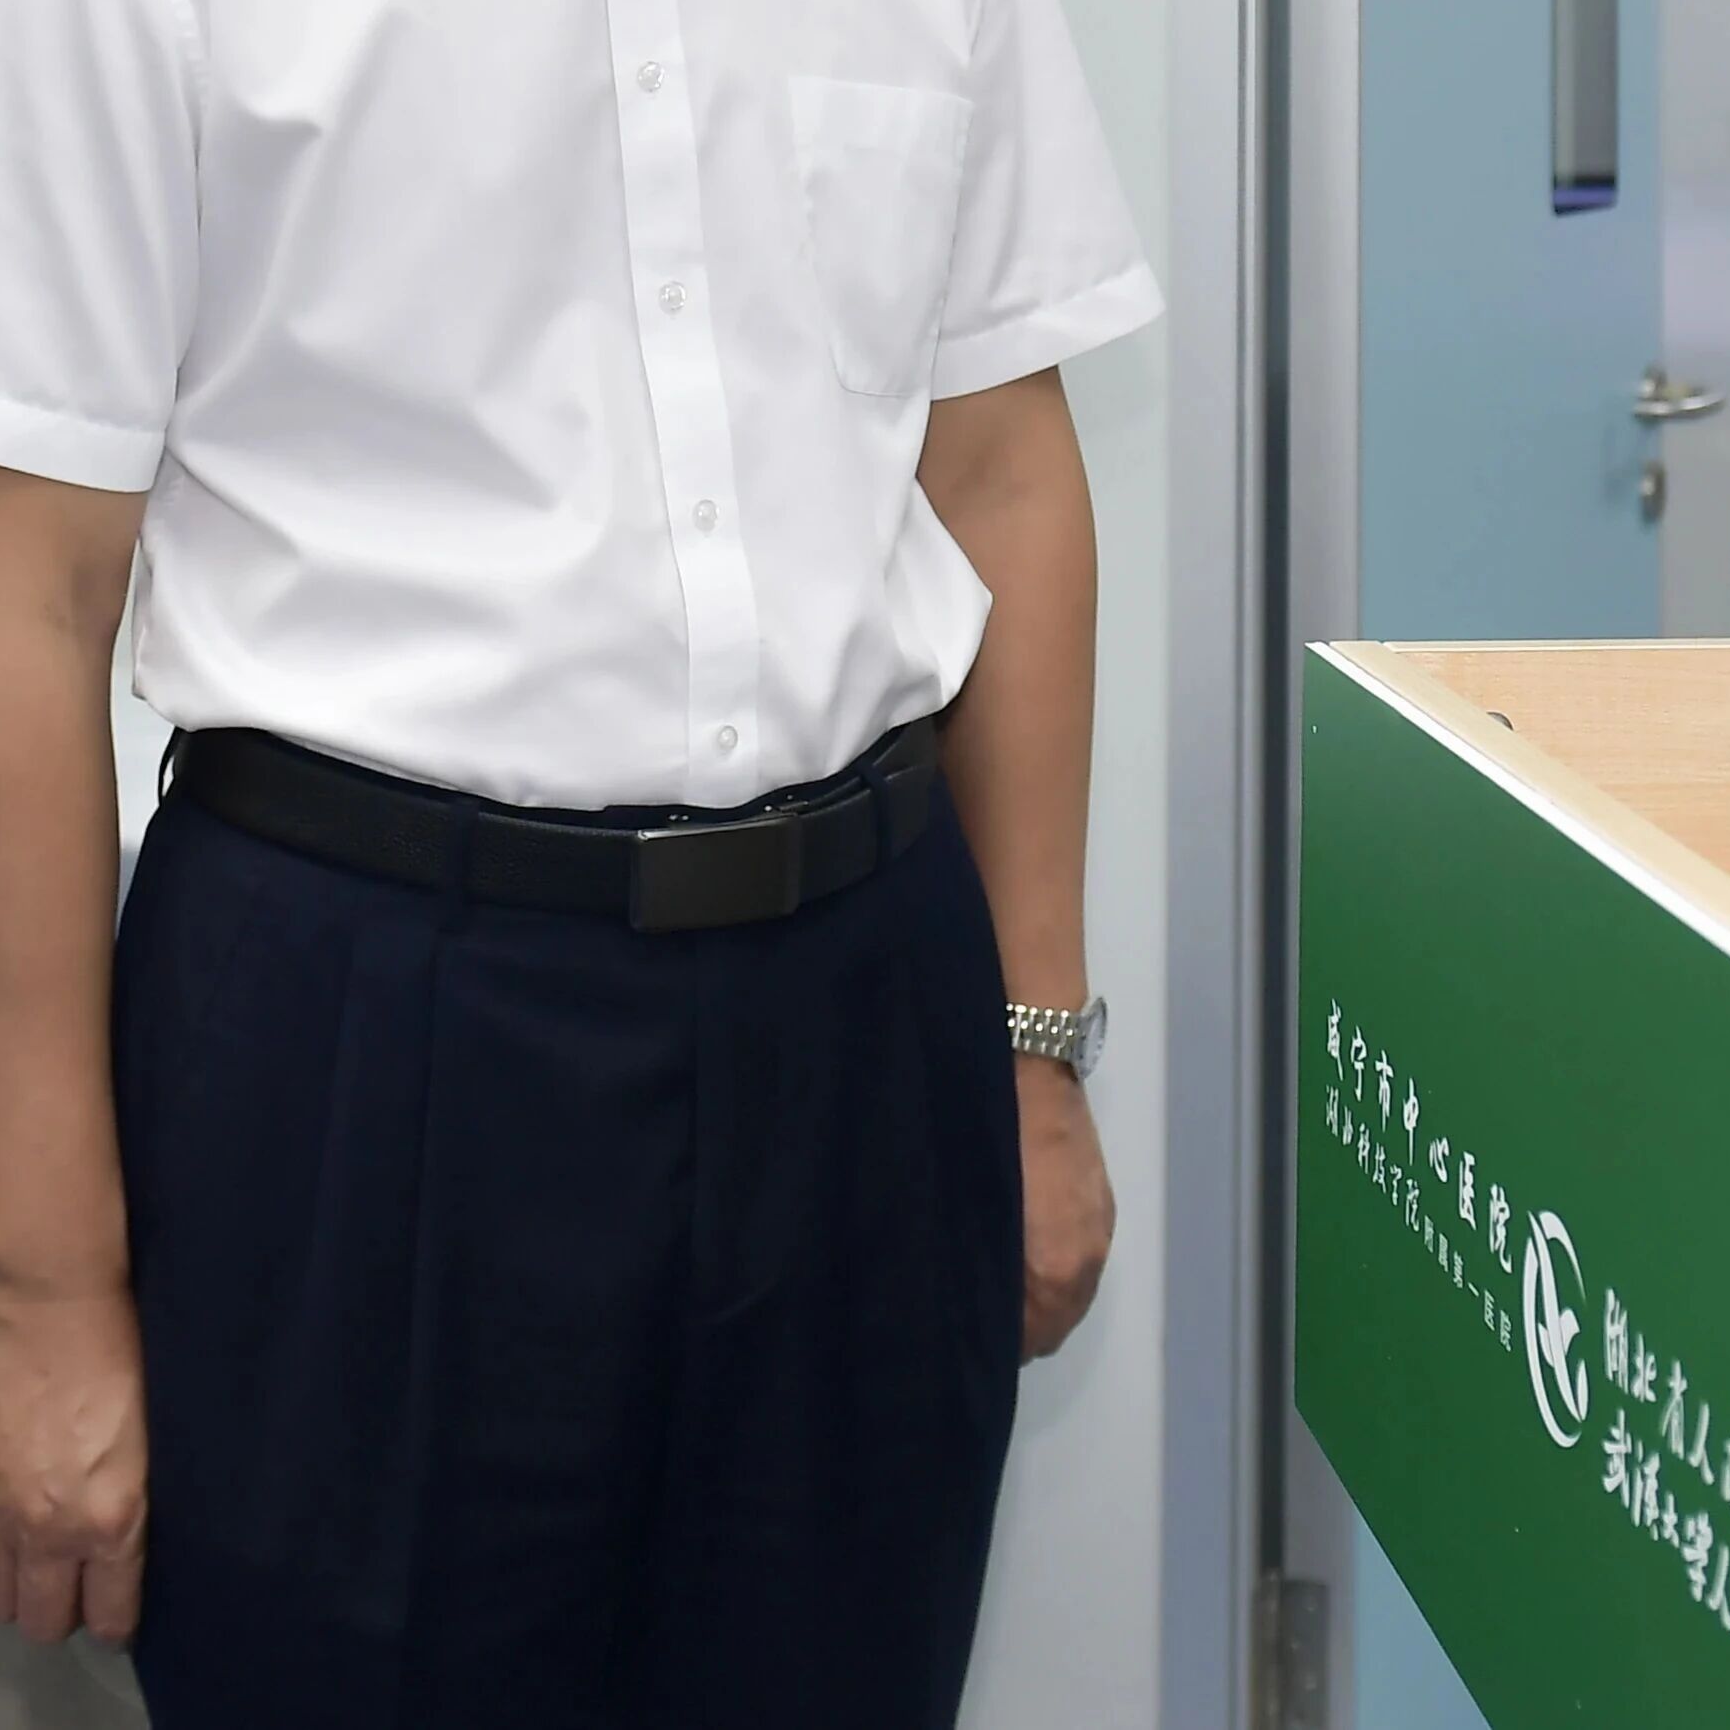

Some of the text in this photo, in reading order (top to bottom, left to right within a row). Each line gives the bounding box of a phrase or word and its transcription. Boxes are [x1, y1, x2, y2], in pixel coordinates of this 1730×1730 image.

[1326, 998, 1513, 1274] 咸宁市中心医院
